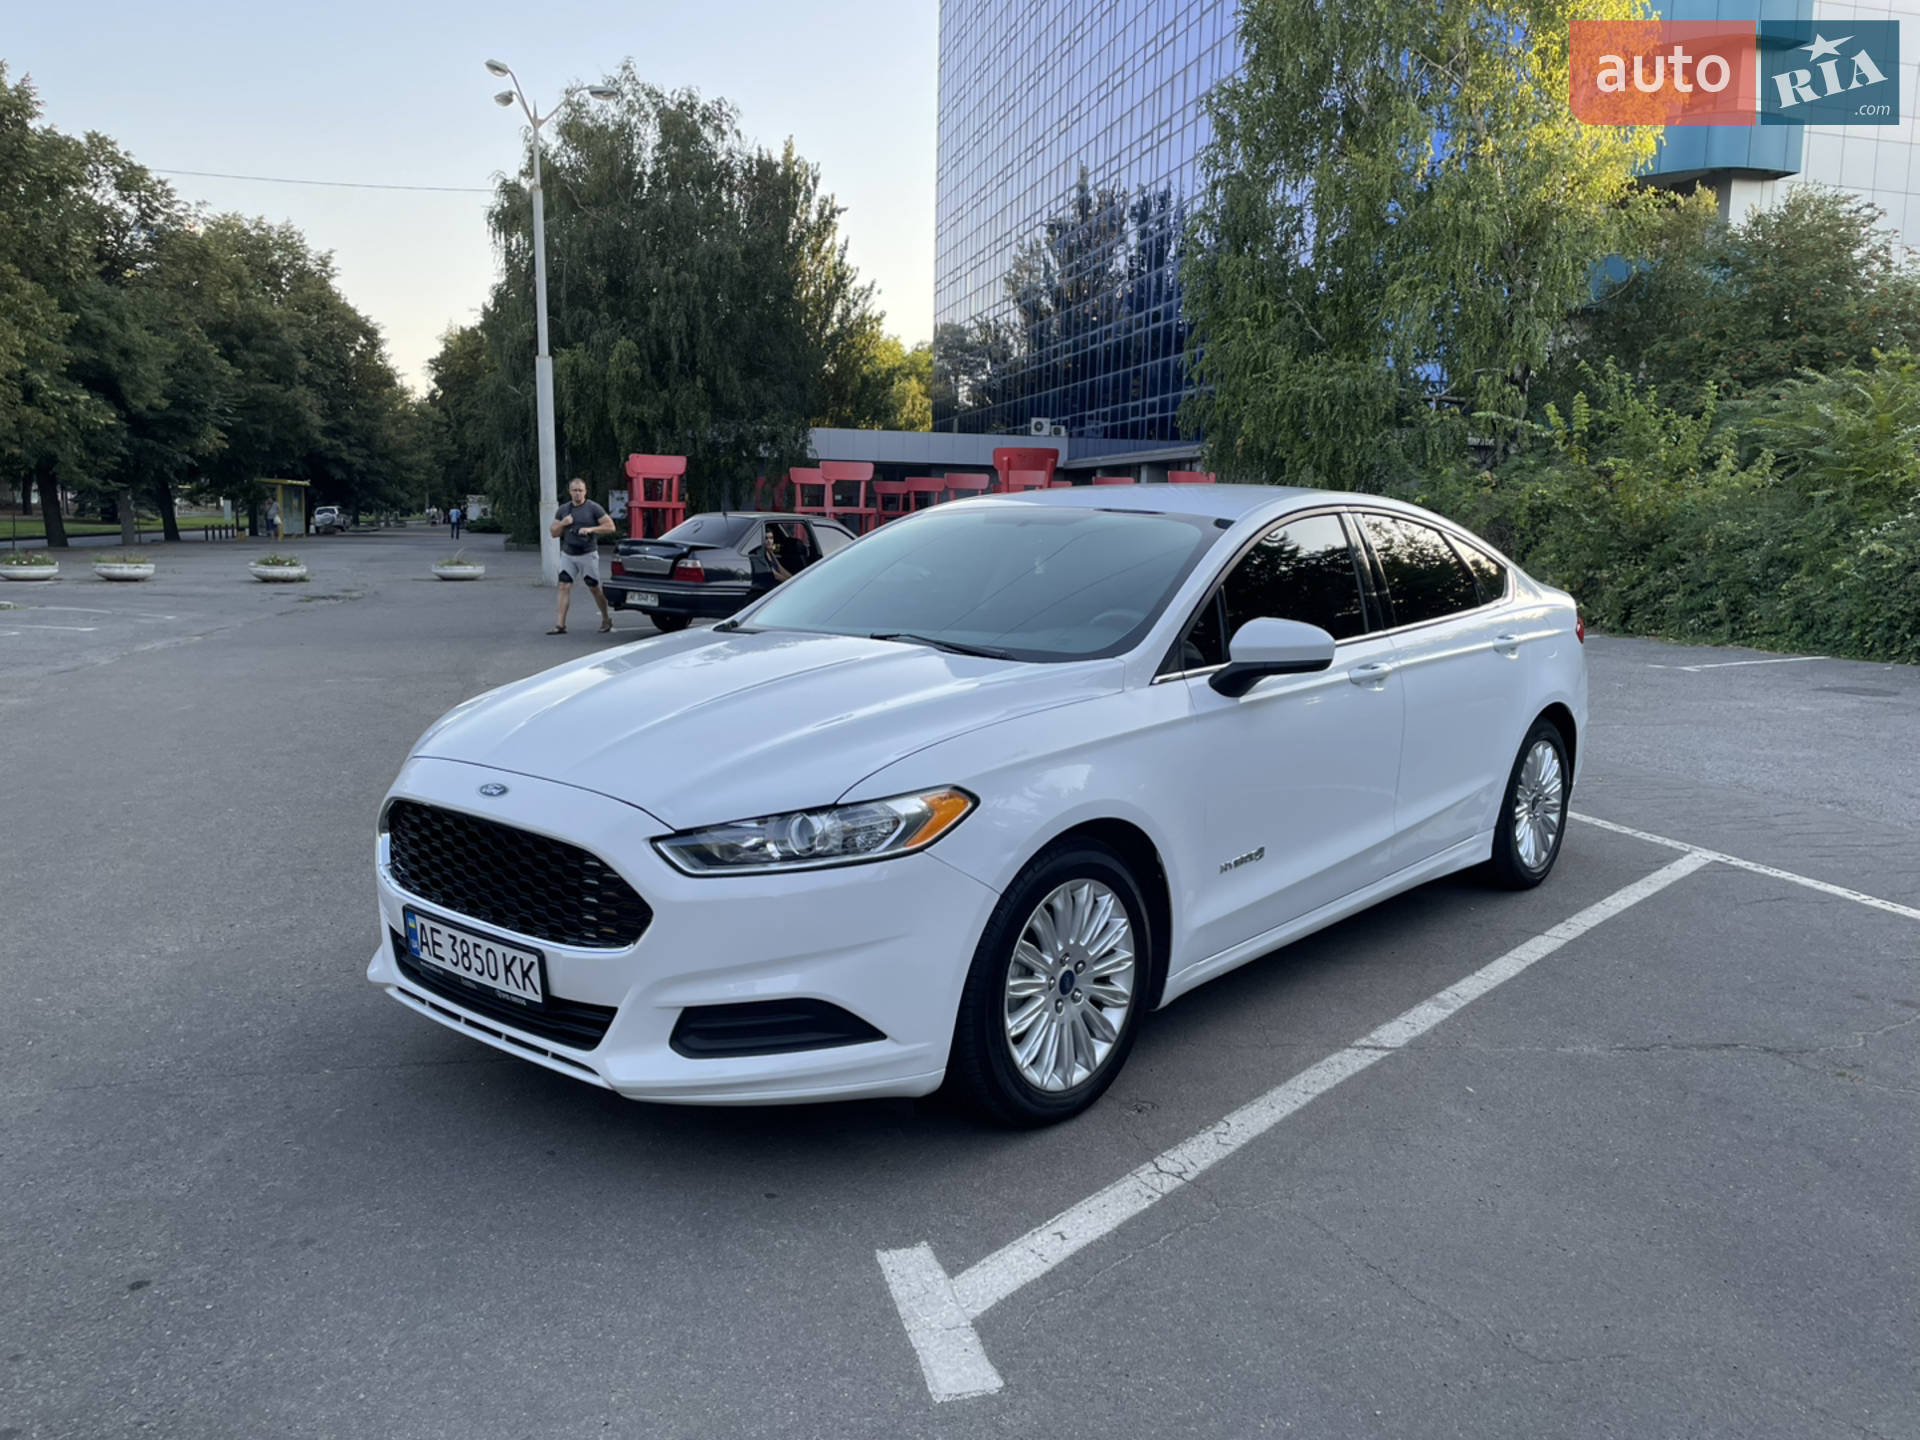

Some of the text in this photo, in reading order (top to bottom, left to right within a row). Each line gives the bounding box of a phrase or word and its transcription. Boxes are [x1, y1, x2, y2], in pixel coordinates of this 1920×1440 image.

[419, 922, 540, 996] AE 3850 KK
